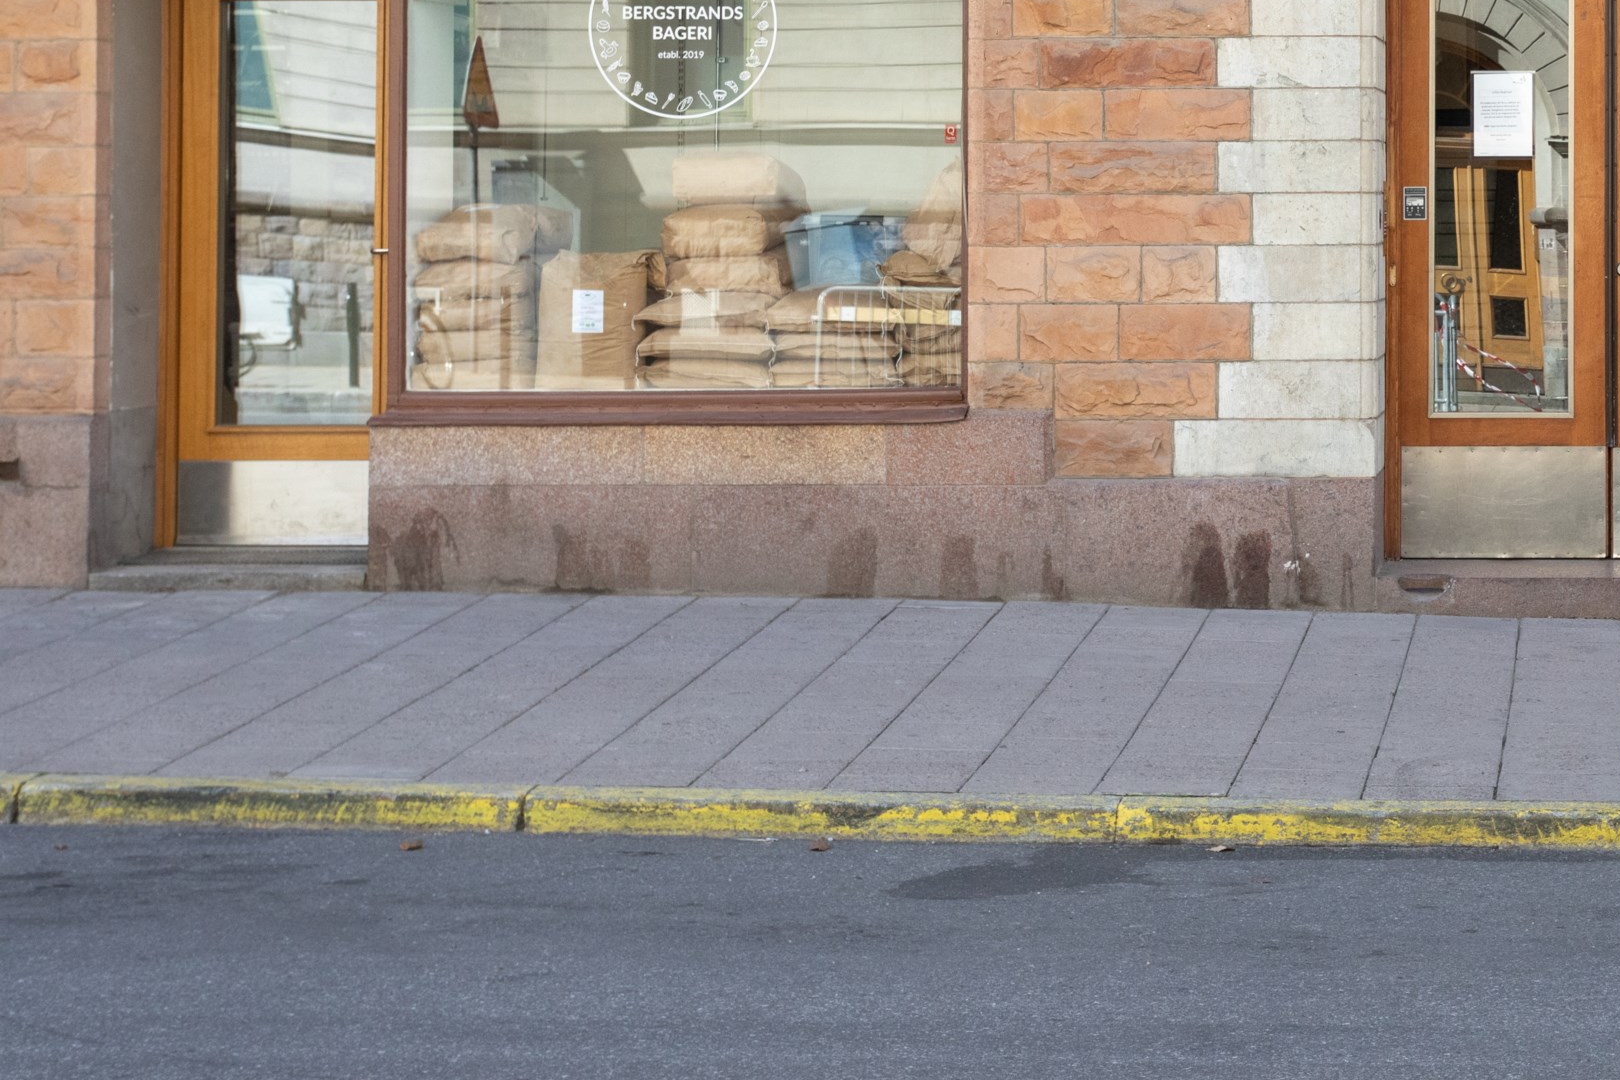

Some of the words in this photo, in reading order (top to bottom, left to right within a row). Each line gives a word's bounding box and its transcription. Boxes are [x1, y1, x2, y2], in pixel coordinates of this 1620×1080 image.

[622, 5, 744, 21] BERGSTRANDS
[652, 25, 713, 41] BAGERI
[657, 50, 681, 60] etabl.
[682, 50, 705, 60] 2019
